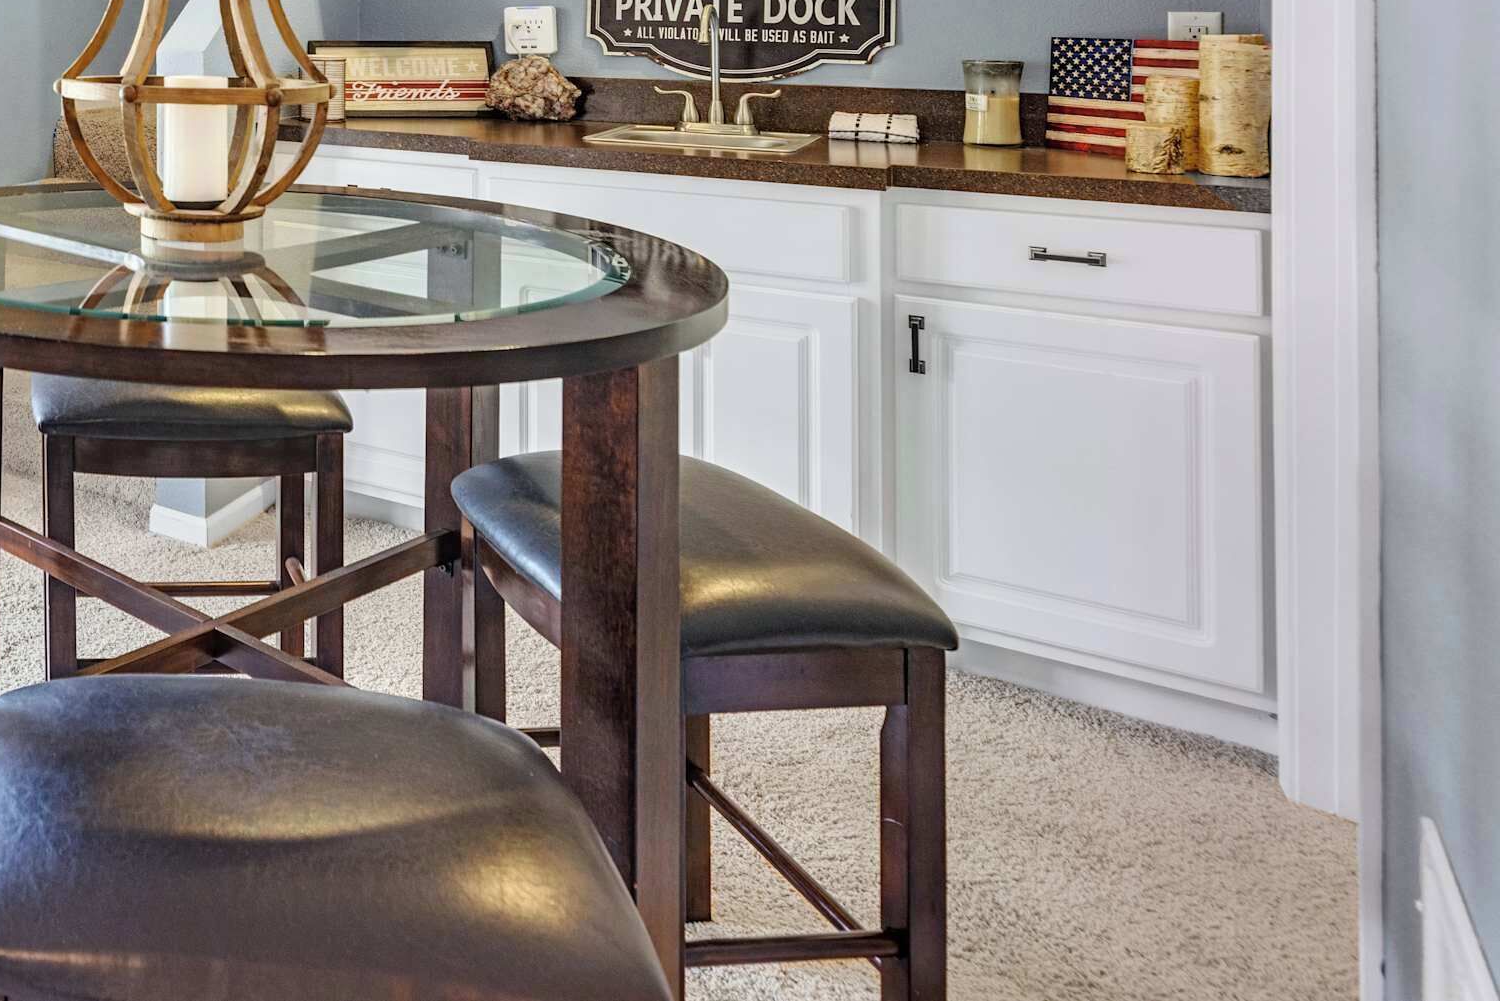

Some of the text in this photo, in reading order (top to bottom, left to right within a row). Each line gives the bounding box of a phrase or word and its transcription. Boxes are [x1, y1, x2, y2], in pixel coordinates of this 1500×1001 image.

[636, 26, 655, 39] ALL
[659, 26, 712, 41] VIOLATO
[745, 28, 758, 42] BE
[762, 29, 789, 43] USED
[792, 30, 806, 44] AS
[810, 30, 835, 44] BAIT
[351, 57, 461, 77] WELCOME
[351, 79, 461, 101] Friends
